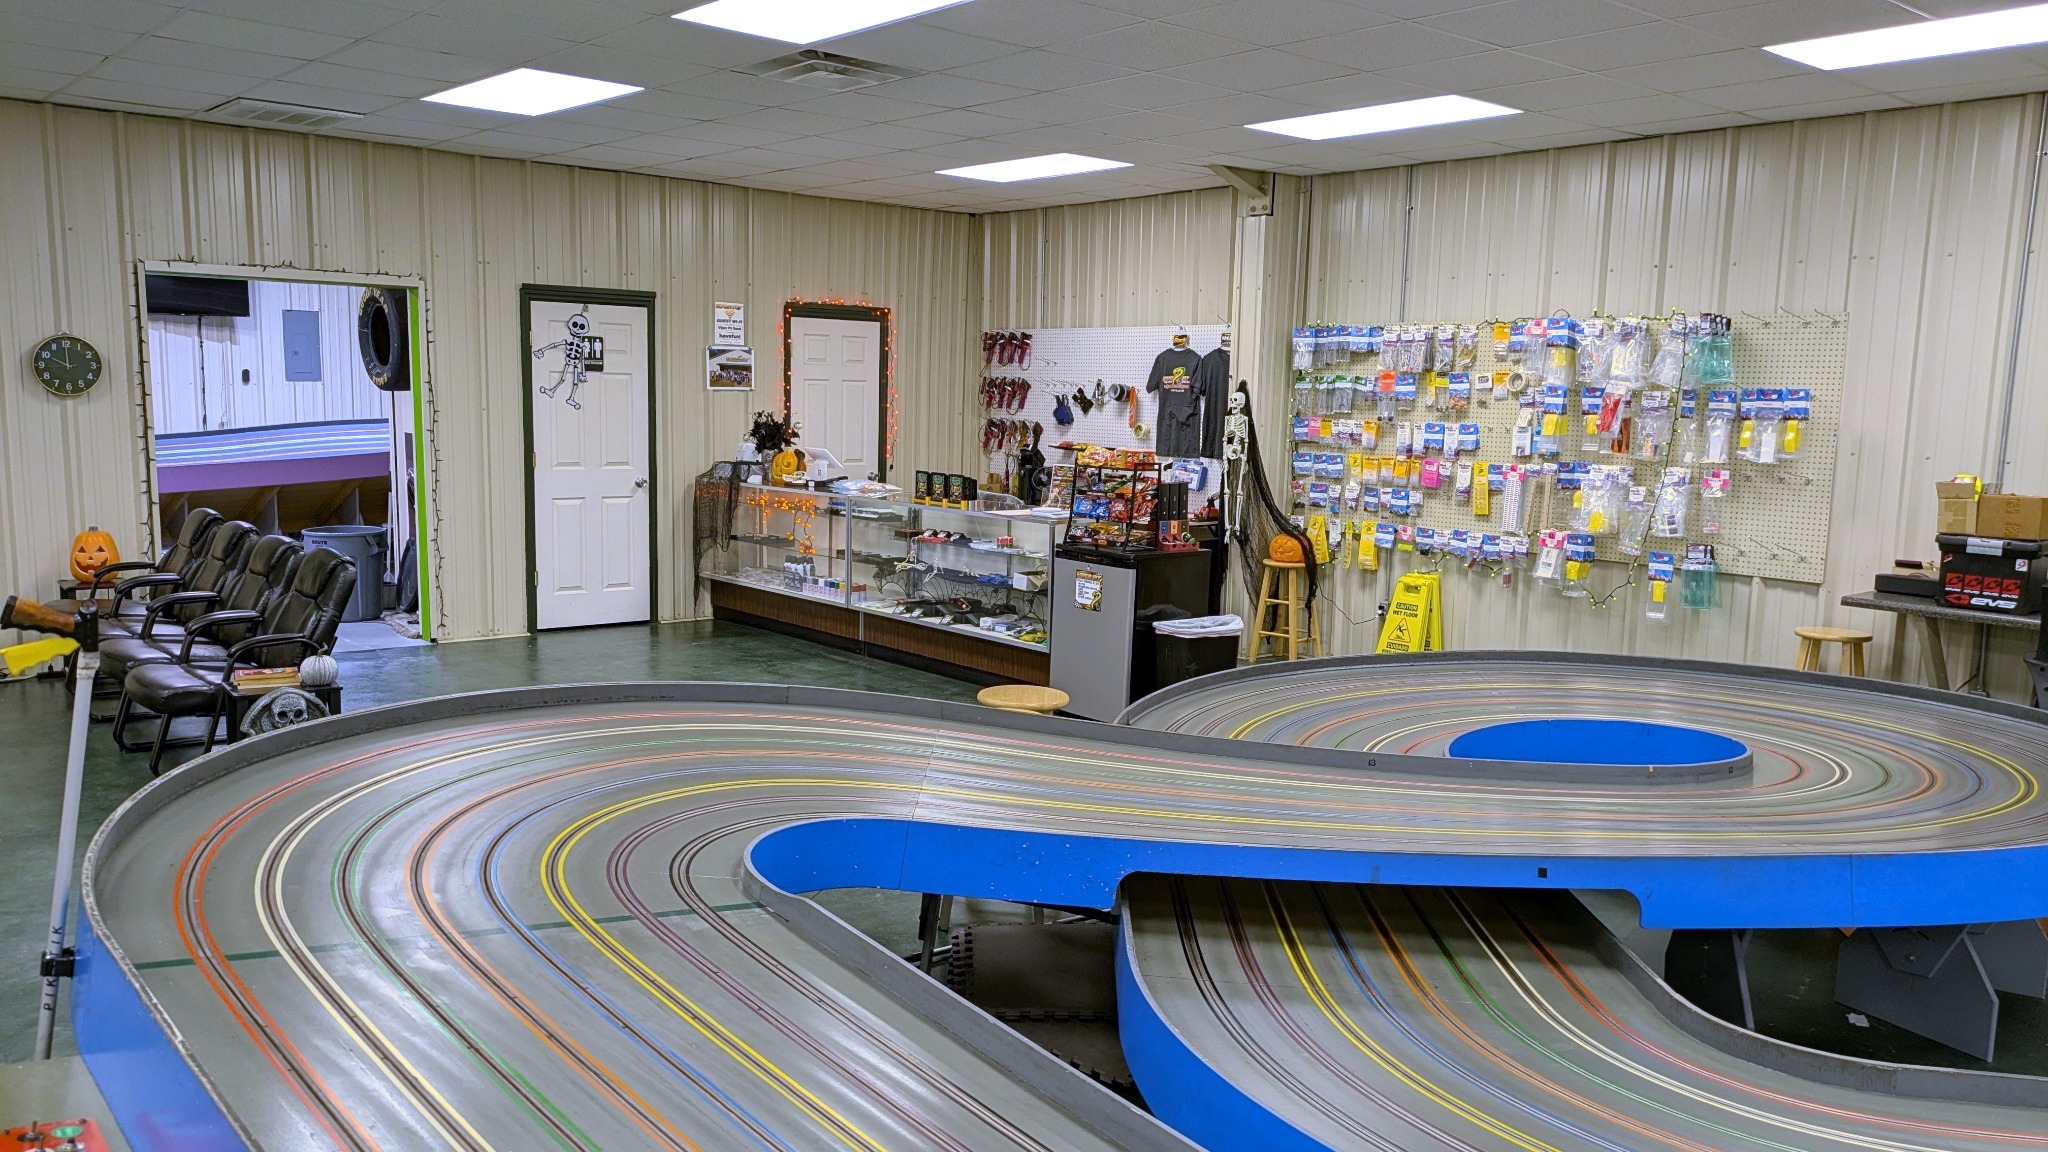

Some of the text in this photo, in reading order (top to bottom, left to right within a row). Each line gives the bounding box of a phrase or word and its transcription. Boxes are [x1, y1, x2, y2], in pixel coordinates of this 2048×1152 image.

[51, 343, 57, 351] 11
[62, 340, 71, 348] 12
[41, 351, 51, 359] 10
[85, 351, 92, 359] 2
[38, 361, 45, 369] 9
[90, 362, 97, 370] 3
[43, 372, 50, 380] 8
[87, 372, 93, 380] 4
[65, 382, 73, 391] 6
[78, 380, 85, 388] 5
[1396, 603, 1418, 611] CAUTION
[1387, 642, 1409, 651] CUIDADO
[1368, 758, 1377, 767] 13
[43, 925, 63, 1011] PIKTIK
